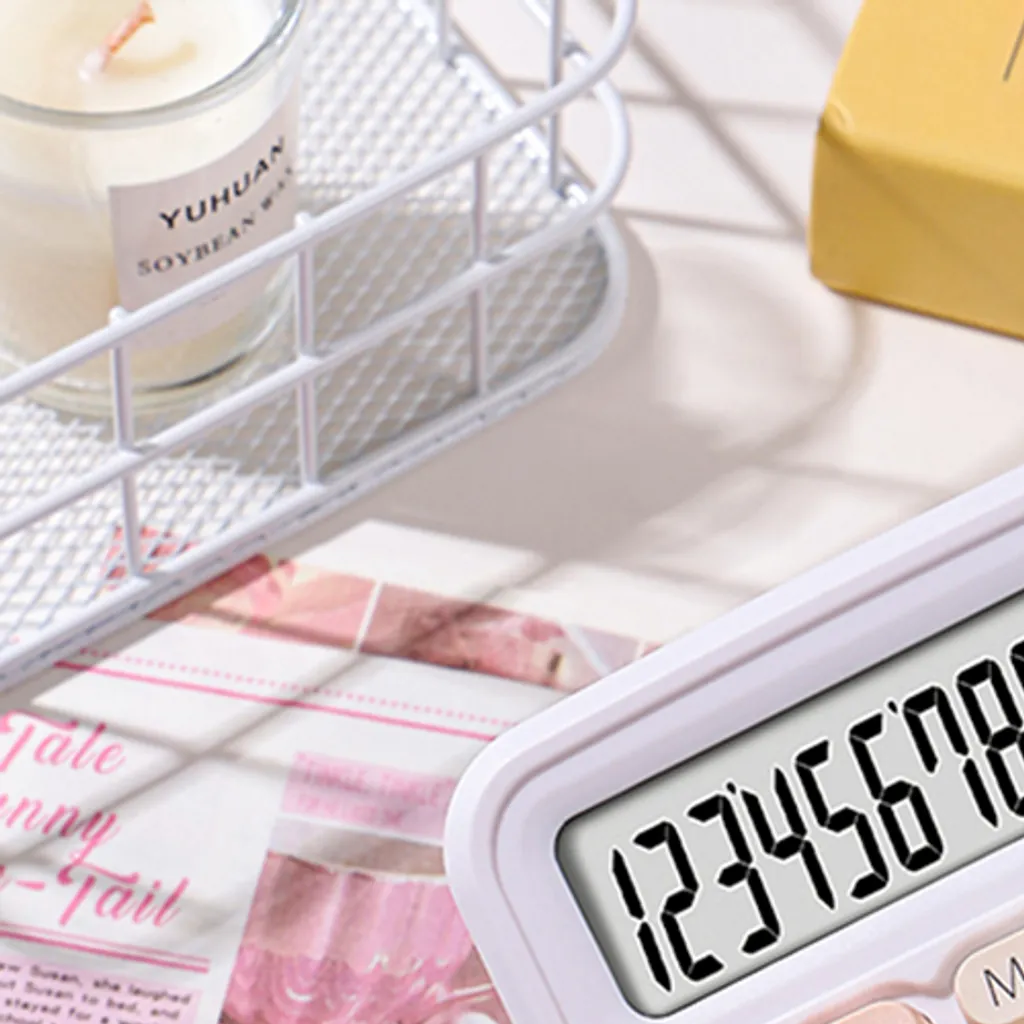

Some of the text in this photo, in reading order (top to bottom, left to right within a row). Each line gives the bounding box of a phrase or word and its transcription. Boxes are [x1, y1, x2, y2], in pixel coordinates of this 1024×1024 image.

[159, 136, 284, 229] YUHUAN
[138, 212, 254, 275] SOYBEAN
[0, 710, 126, 774] Tale
[0, 793, 121, 862] nny
